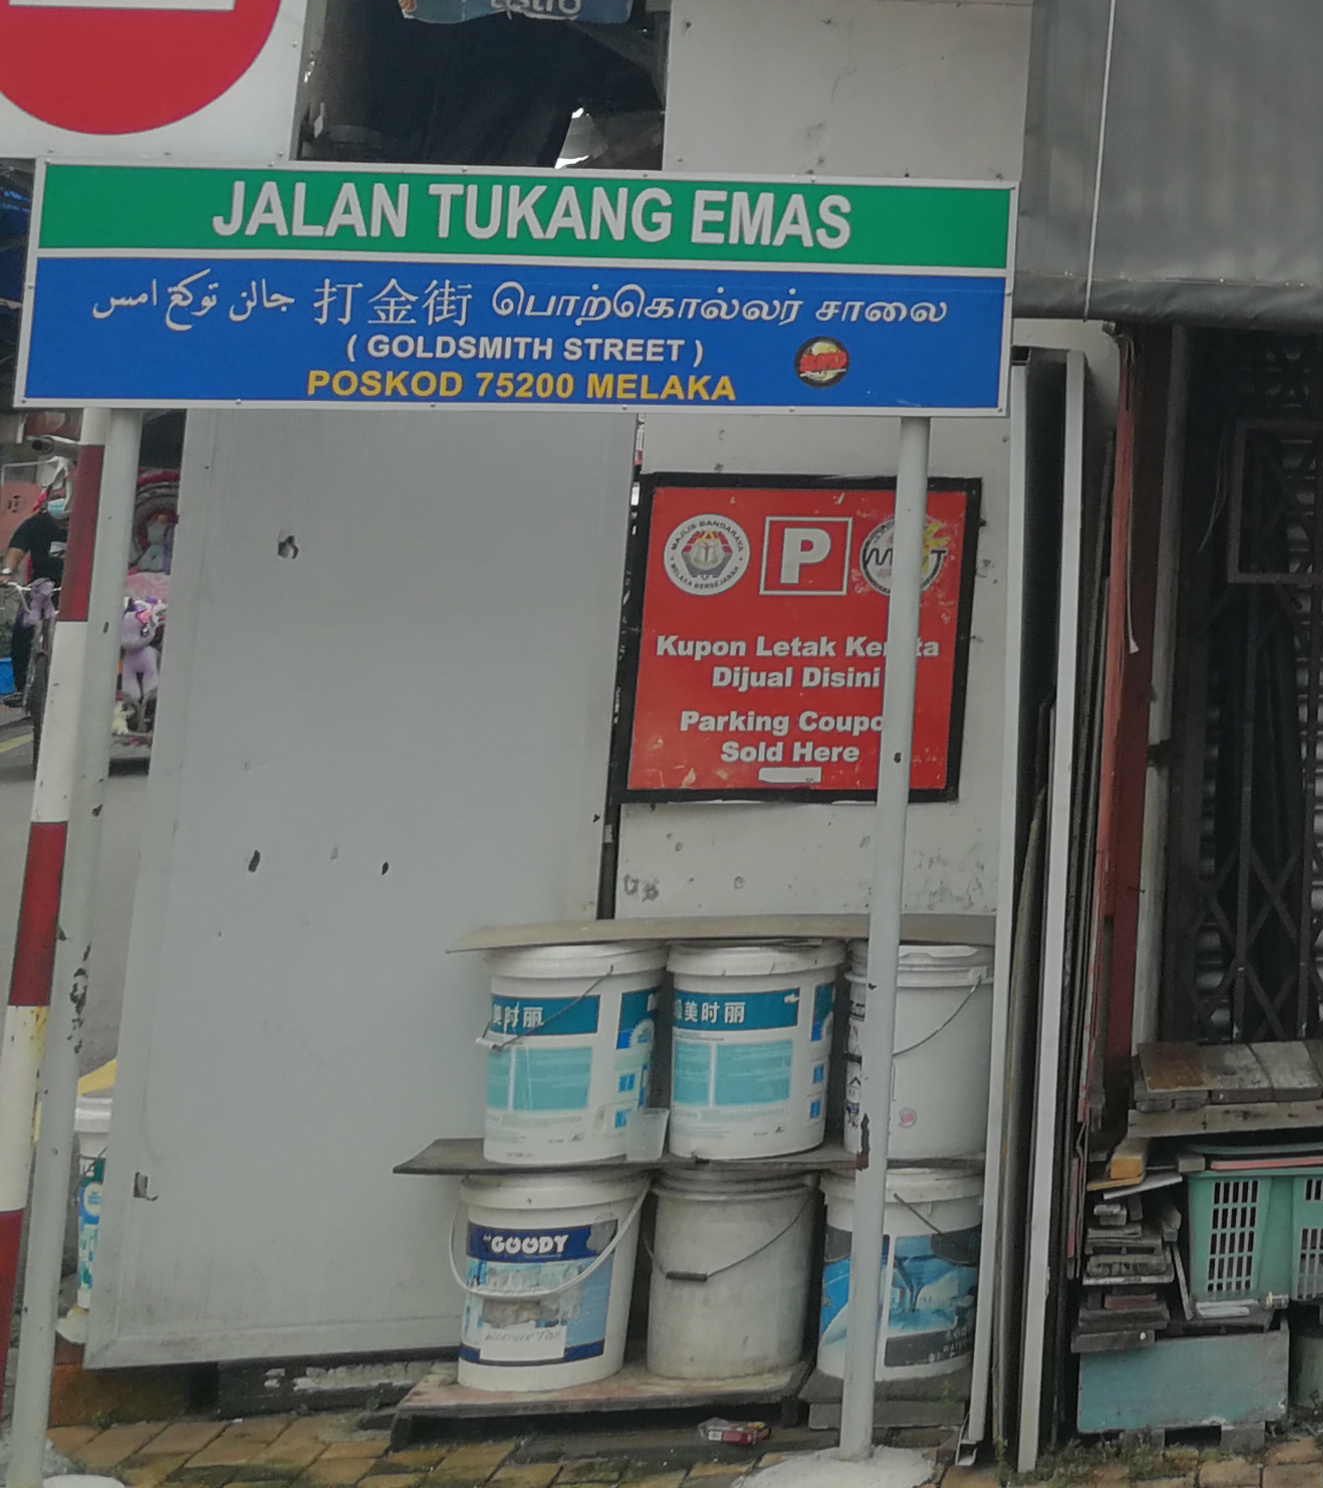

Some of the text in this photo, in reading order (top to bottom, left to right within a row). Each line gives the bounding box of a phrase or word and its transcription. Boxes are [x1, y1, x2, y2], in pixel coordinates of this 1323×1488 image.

[212, 181, 851, 249] JALAN TUKANG EMAS
[313, 277, 473, 327] 打金街
[815, 299, 947, 323] சாலை
[367, 335, 553, 361] GOLDSMITH
[563, 338, 684, 363] STREET
[307, 369, 737, 402] POSKOD 75200 MELAKA
[780, 527, 832, 585] P
[656, 635, 746, 661] Kupon
[756, 635, 835, 657] Letak
[712, 666, 880, 692] Dijual Disini
[680, 710, 884, 736] Parking Coupo
[720, 742, 860, 764] Sold Here
